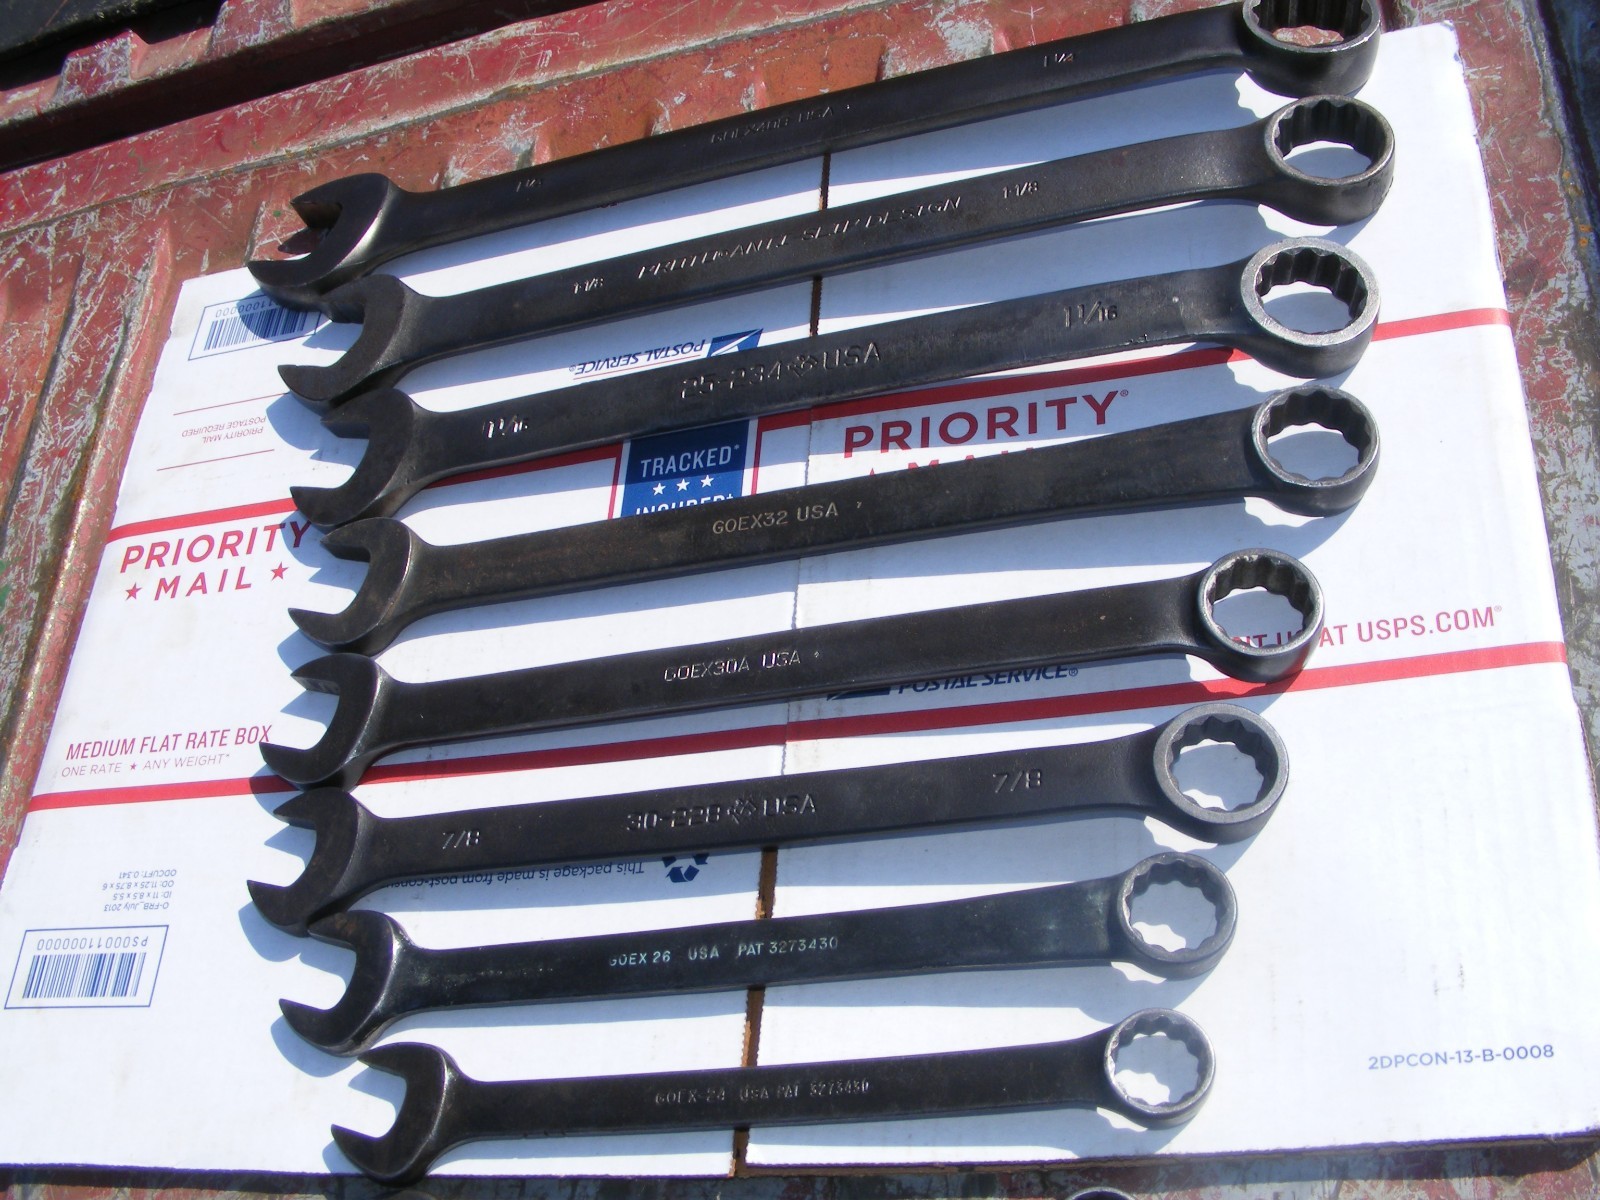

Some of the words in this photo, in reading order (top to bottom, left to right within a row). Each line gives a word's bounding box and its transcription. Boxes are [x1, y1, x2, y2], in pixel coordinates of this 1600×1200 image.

[639, 338, 706, 366] POSTAL
[680, 359, 783, 399] 25-234
[822, 341, 881, 371] USA
[181, 423, 225, 438] REQUIRED
[221, 426, 264, 440] PRIORITY
[227, 415, 266, 430] POSTAGE
[711, 510, 789, 536] GOEX32
[796, 502, 840, 523] USA
[119, 520, 312, 574] PRIORITY
[153, 566, 252, 602] MAIL
[1319, 624, 1347, 648] AT
[663, 656, 751, 682] GOEX30A
[760, 650, 802, 669] USA
[66, 738, 136, 760] MEDIUM
[139, 733, 182, 754] FLAT
[185, 729, 231, 750] RATE
[234, 725, 273, 746] BOX
[61, 766, 87, 778] ONE
[90, 762, 123, 774] RATE
[142, 757, 171, 771] ANY
[992, 770, 1042, 793] 7/8
[626, 804, 721, 831] 30-228
[763, 793, 816, 816] USA
[440, 828, 481, 850] 7/8
[497, 870, 536, 883] made
[539, 870, 549, 879] is
[553, 864, 613, 879] package
[616, 860, 645, 875] This
[462, 874, 494, 886] from
[651, 950, 672, 964] 26
[688, 944, 720, 961] USA
[738, 941, 764, 959] PAT
[1368, 1044, 1555, 1070] 2DPCON-13-B-0008
[739, 1085, 770, 1102] USA
